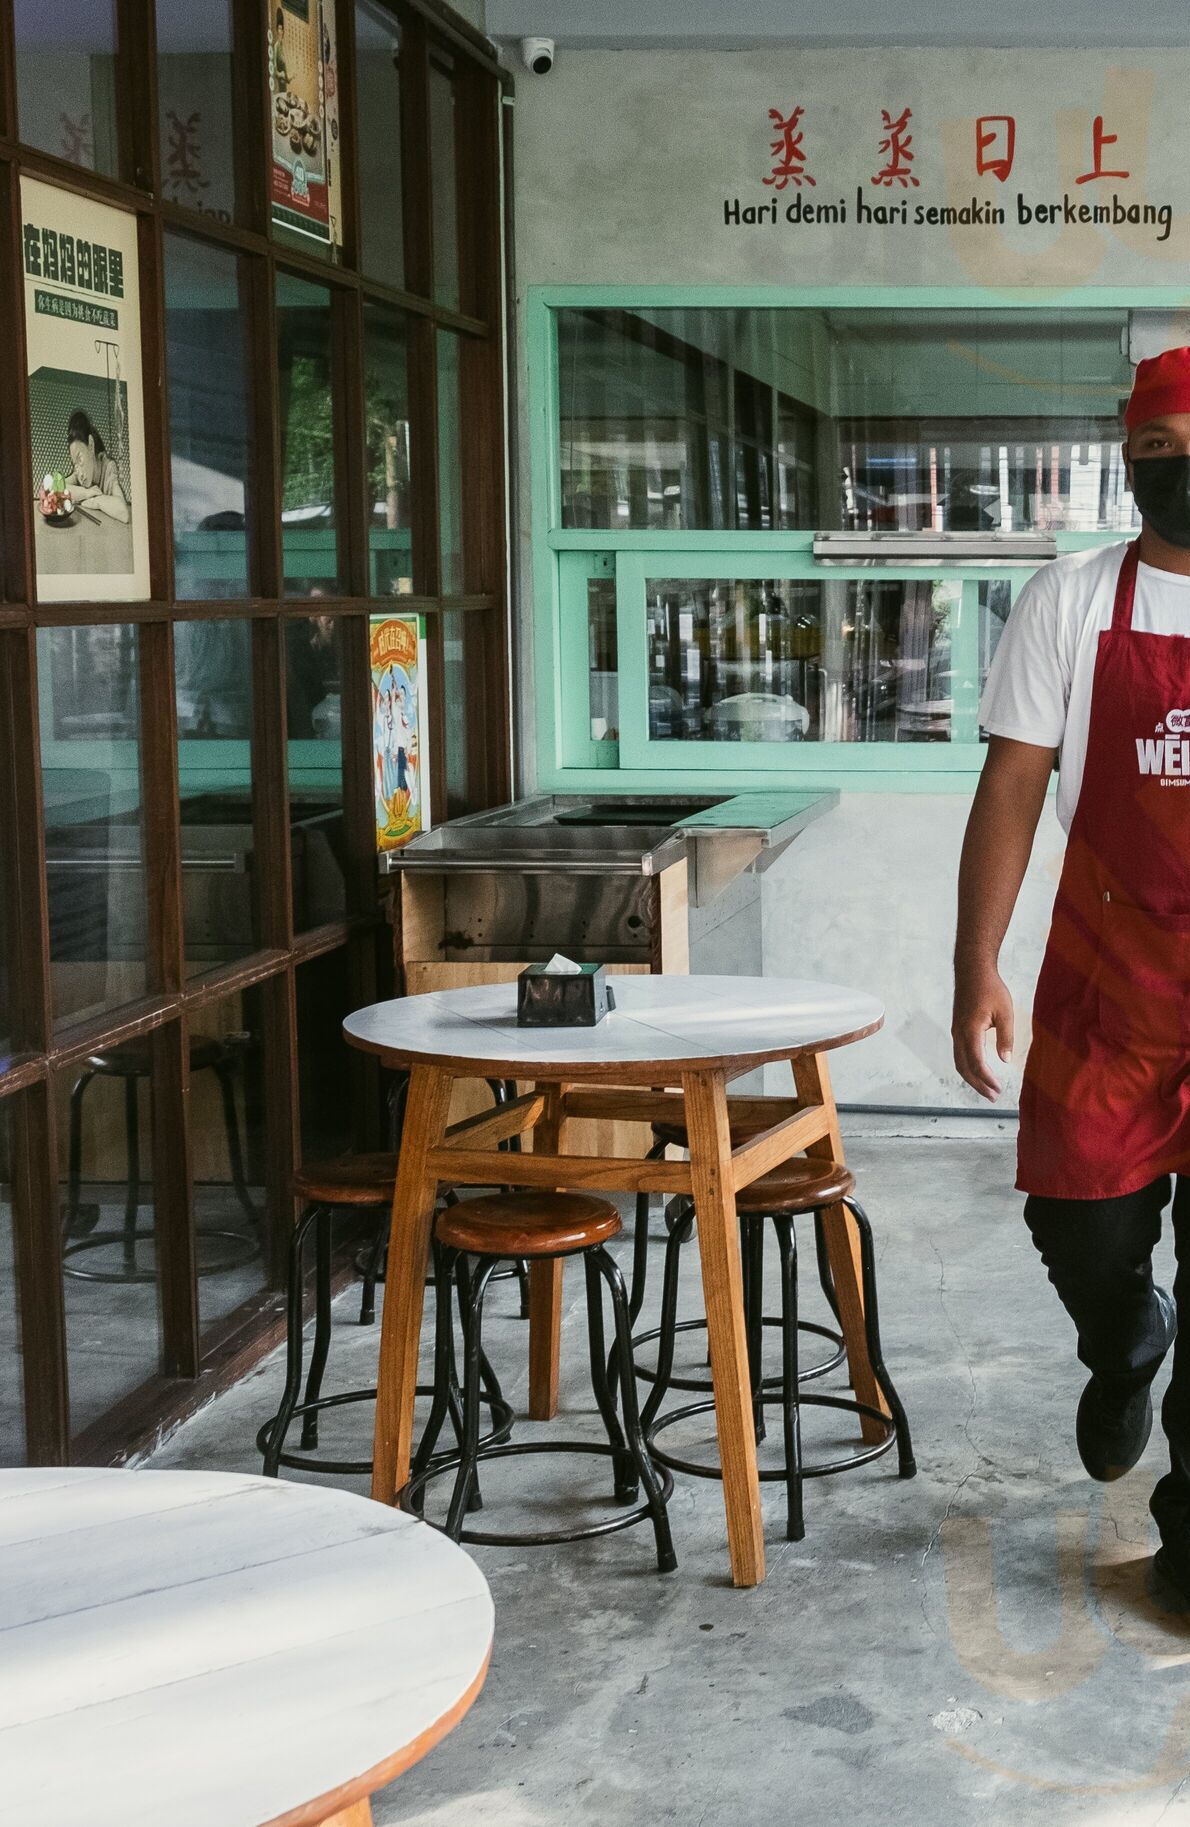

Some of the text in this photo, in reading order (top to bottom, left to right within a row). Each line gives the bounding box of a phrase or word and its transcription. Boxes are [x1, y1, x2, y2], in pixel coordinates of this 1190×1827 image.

[761, 105, 1130, 191] 蒸蒸日上
[724, 186, 1173, 241] Hari demi hari semakin berkembang
